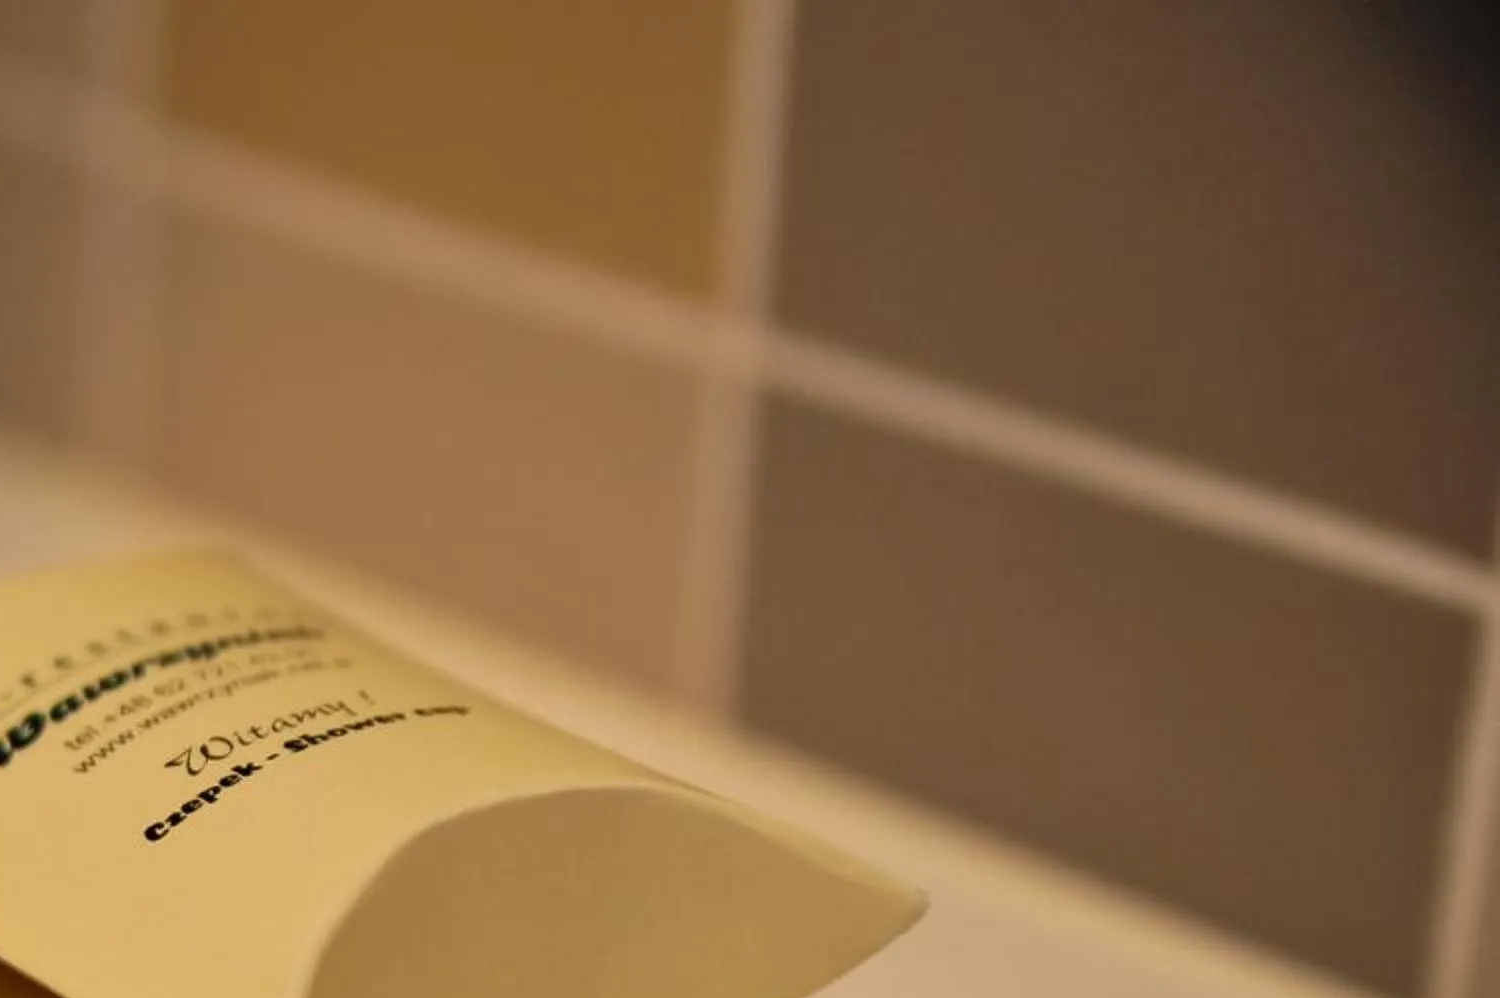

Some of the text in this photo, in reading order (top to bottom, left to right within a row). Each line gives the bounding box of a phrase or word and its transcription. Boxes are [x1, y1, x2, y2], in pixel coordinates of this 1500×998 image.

[143, 761, 263, 843] Czepek
[284, 711, 407, 752] Shower
[162, 700, 358, 777] Witamy
